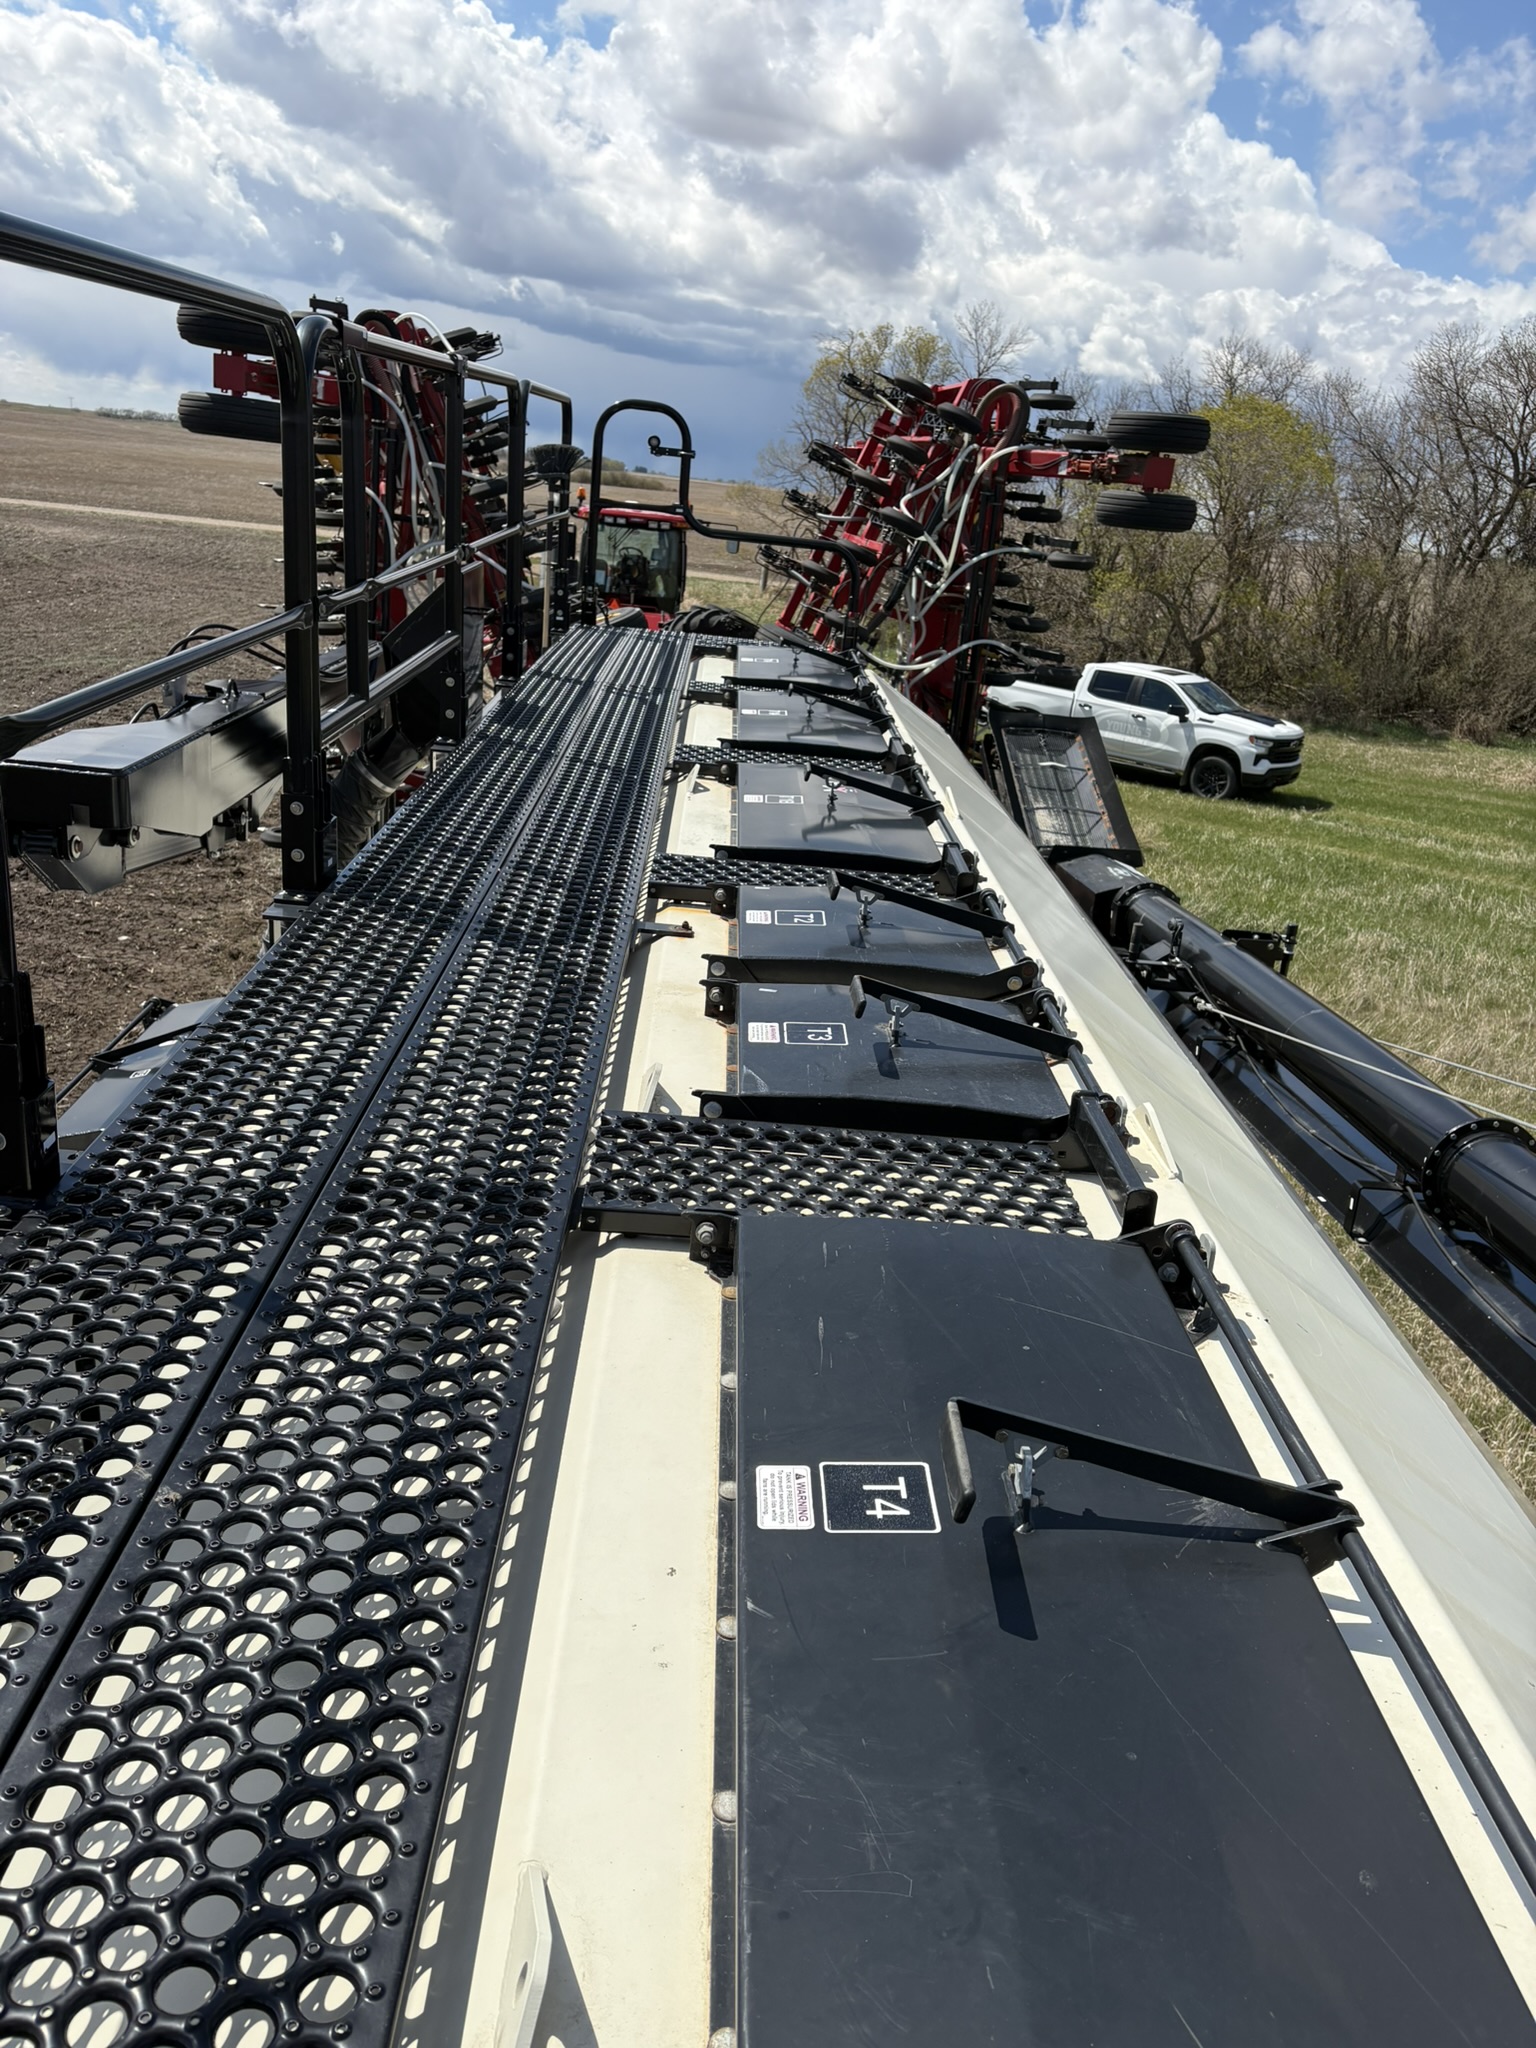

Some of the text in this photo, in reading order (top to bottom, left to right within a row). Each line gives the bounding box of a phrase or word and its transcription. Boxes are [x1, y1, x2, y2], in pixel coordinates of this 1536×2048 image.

[794, 913, 814, 923] T2
[807, 1027, 832, 1041] T3
[787, 1490, 795, 1524] PRESSURIZED
[797, 1482, 809, 1522] WARNING
[863, 1476, 910, 1519] T4
